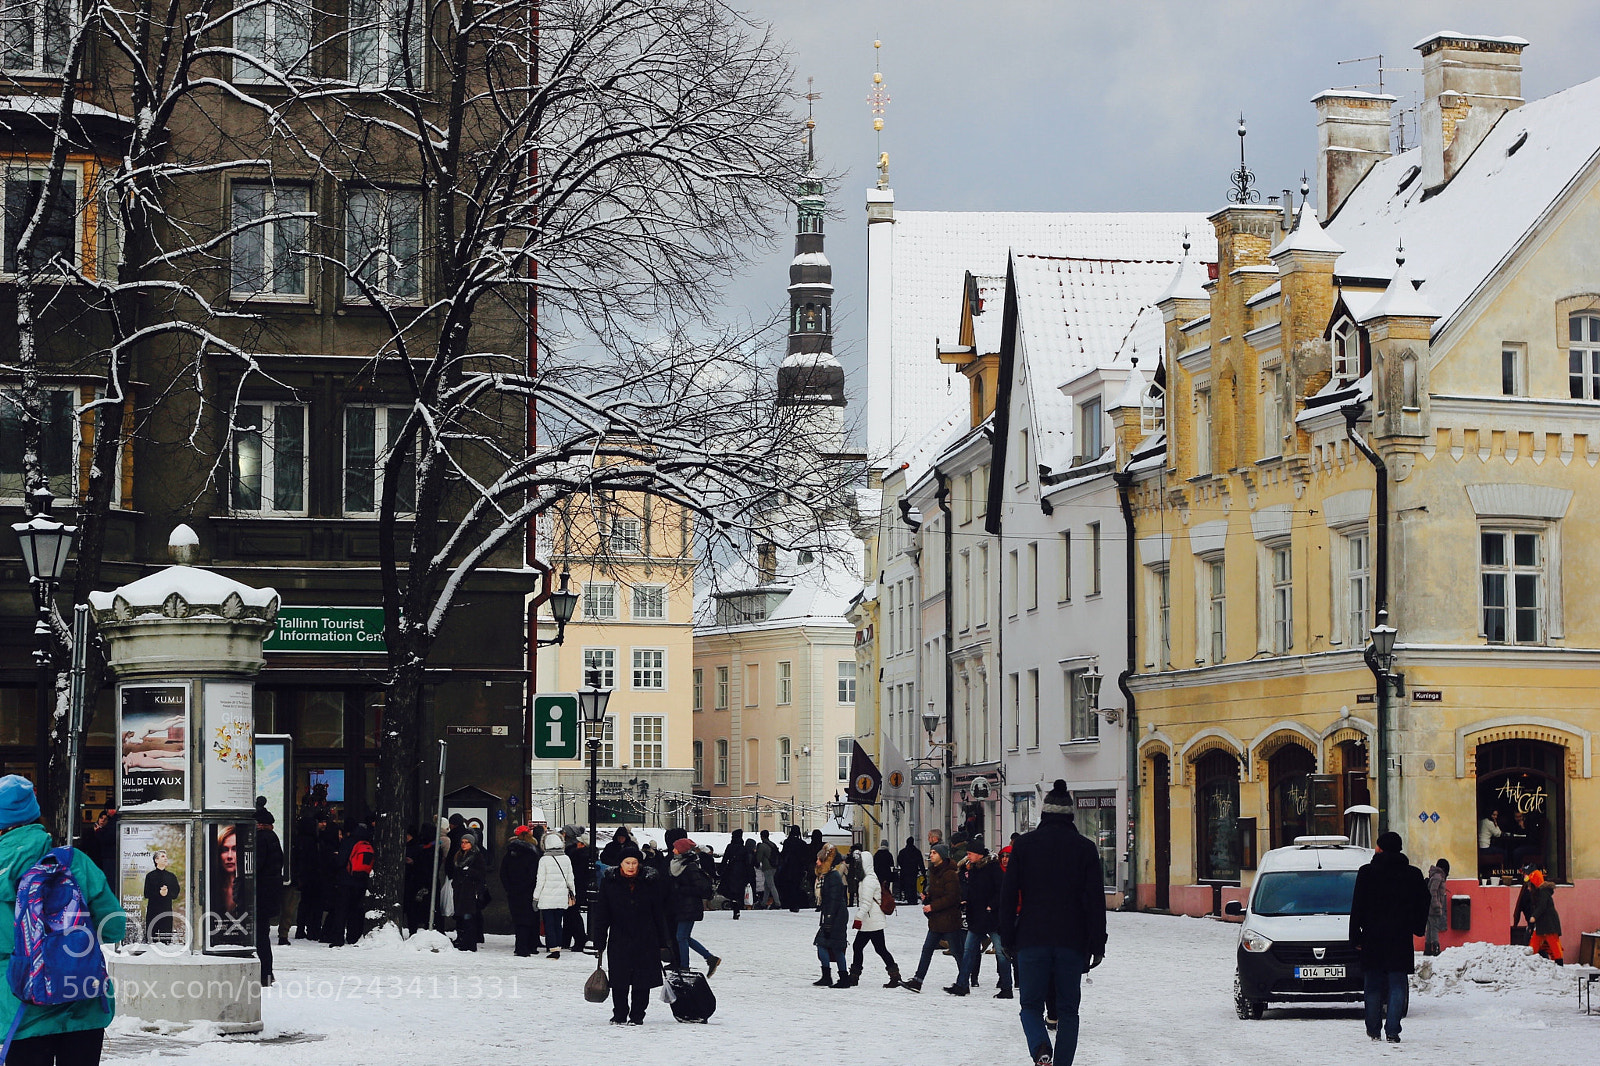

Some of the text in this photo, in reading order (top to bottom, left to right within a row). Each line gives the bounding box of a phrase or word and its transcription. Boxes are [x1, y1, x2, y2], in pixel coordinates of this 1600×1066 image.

[278, 617, 365, 630] Tallinn Tourist
[280, 630, 382, 642] Information Cen
[1415, 692, 1439, 700] Kuninga
[122, 777, 182, 786] PAUL DELVAUX
[1302, 968, 1344, 977] 014 PUH
